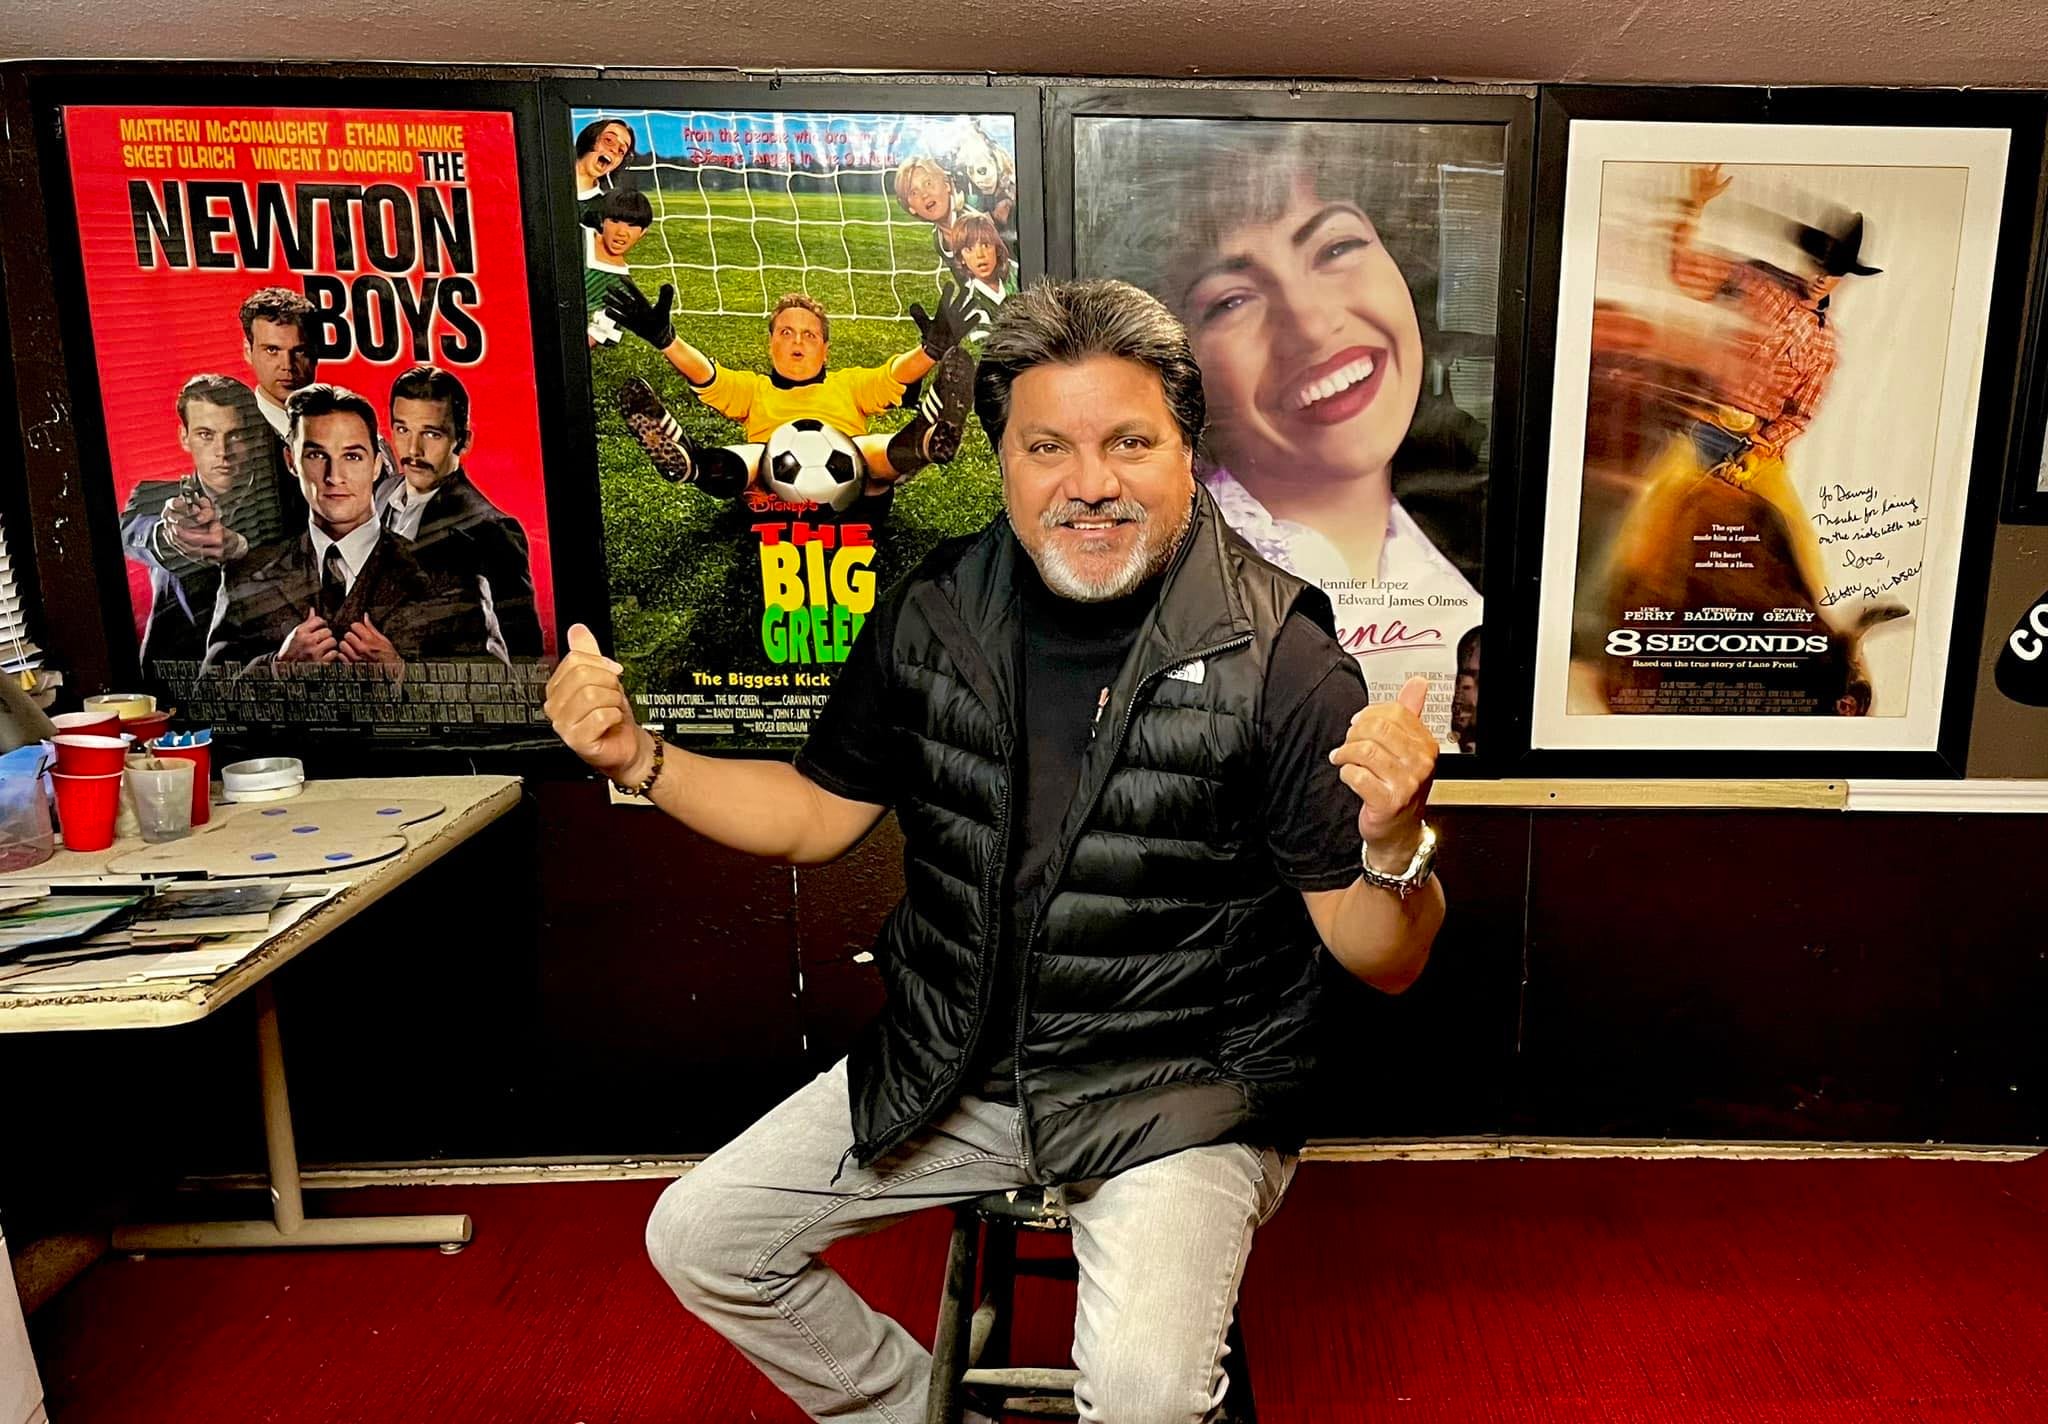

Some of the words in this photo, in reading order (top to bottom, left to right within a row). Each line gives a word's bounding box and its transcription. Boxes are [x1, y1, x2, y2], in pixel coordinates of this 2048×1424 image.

[119, 118, 200, 143] MATTHEW
[205, 119, 328, 145] McCONAUGHEY
[345, 122, 400, 147] ETHAN
[404, 124, 464, 148] HAWKE
[684, 128, 714, 143] From
[719, 128, 739, 143] the
[744, 131, 789, 146] people
[123, 144, 173, 168] SKEET
[178, 146, 236, 169] ULRICH
[251, 147, 321, 171] VINCENT
[327, 149, 414, 173] D'ONOFRIO
[417, 151, 466, 182] THE
[127, 179, 476, 275] NEWTON
[302, 274, 486, 364] BOYS
[750, 522, 874, 548] THE
[1711, 523, 1726, 532] The
[759, 540, 877, 614] BIG
[1319, 578, 1368, 591] Jennifer
[1371, 578, 1409, 594] Lopez
[1338, 594, 1385, 607] Edward
[1388, 595, 1425, 608] James
[1427, 595, 1469, 608] Olmos
[1623, 611, 1676, 621] PERRY
[1683, 611, 1755, 622] BALDWIN
[1763, 612, 1816, 623] GEARY
[1605, 629, 1642, 657] 8
[1645, 634, 1829, 653] SECONDS
[1632, 660, 1659, 668] Based
[1674, 660, 1689, 668] the
[1690, 661, 1710, 669] true
[1710, 661, 1735, 669] story
[1736, 660, 1747, 669] of
[1748, 661, 1770, 669] Lane
[692, 671, 722, 686] The
[728, 672, 789, 689] Biggest
[795, 672, 831, 687] Kick
[635, 693, 653, 705] WALT
[653, 693, 676, 705] DISNEY
